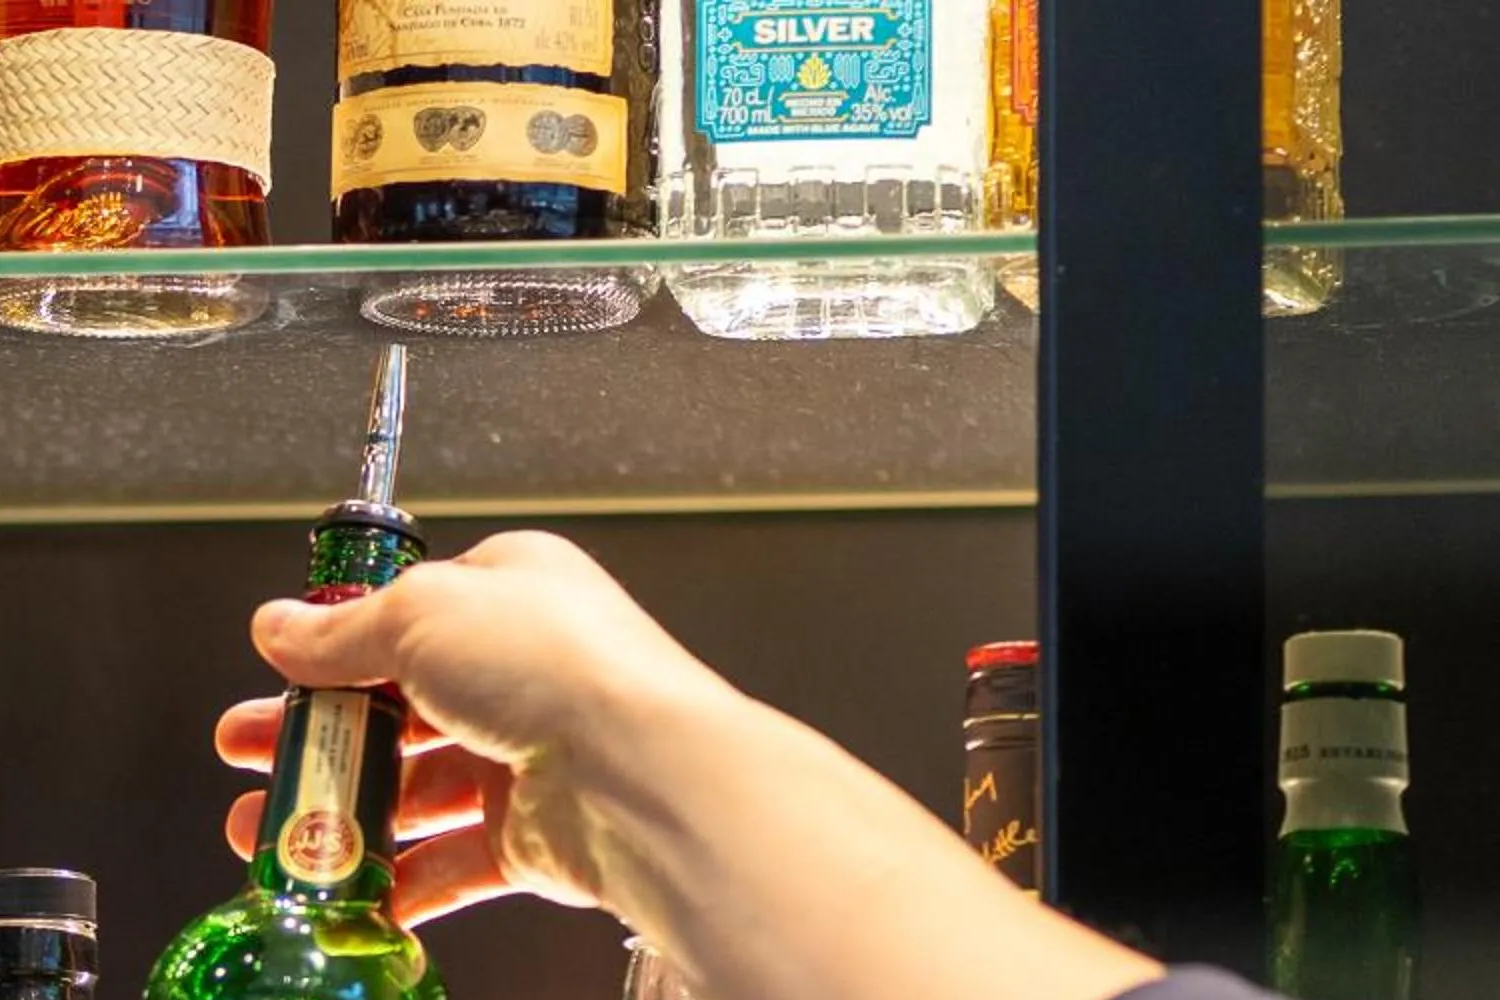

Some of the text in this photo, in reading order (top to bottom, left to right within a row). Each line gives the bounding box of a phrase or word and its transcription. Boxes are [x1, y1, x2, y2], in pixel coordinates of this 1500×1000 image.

[498, 17, 526, 29] 1872
[754, 16, 875, 44] SILVER
[722, 87, 743, 105] 70
[720, 106, 749, 125] 700
[851, 104, 886, 122] 35%
